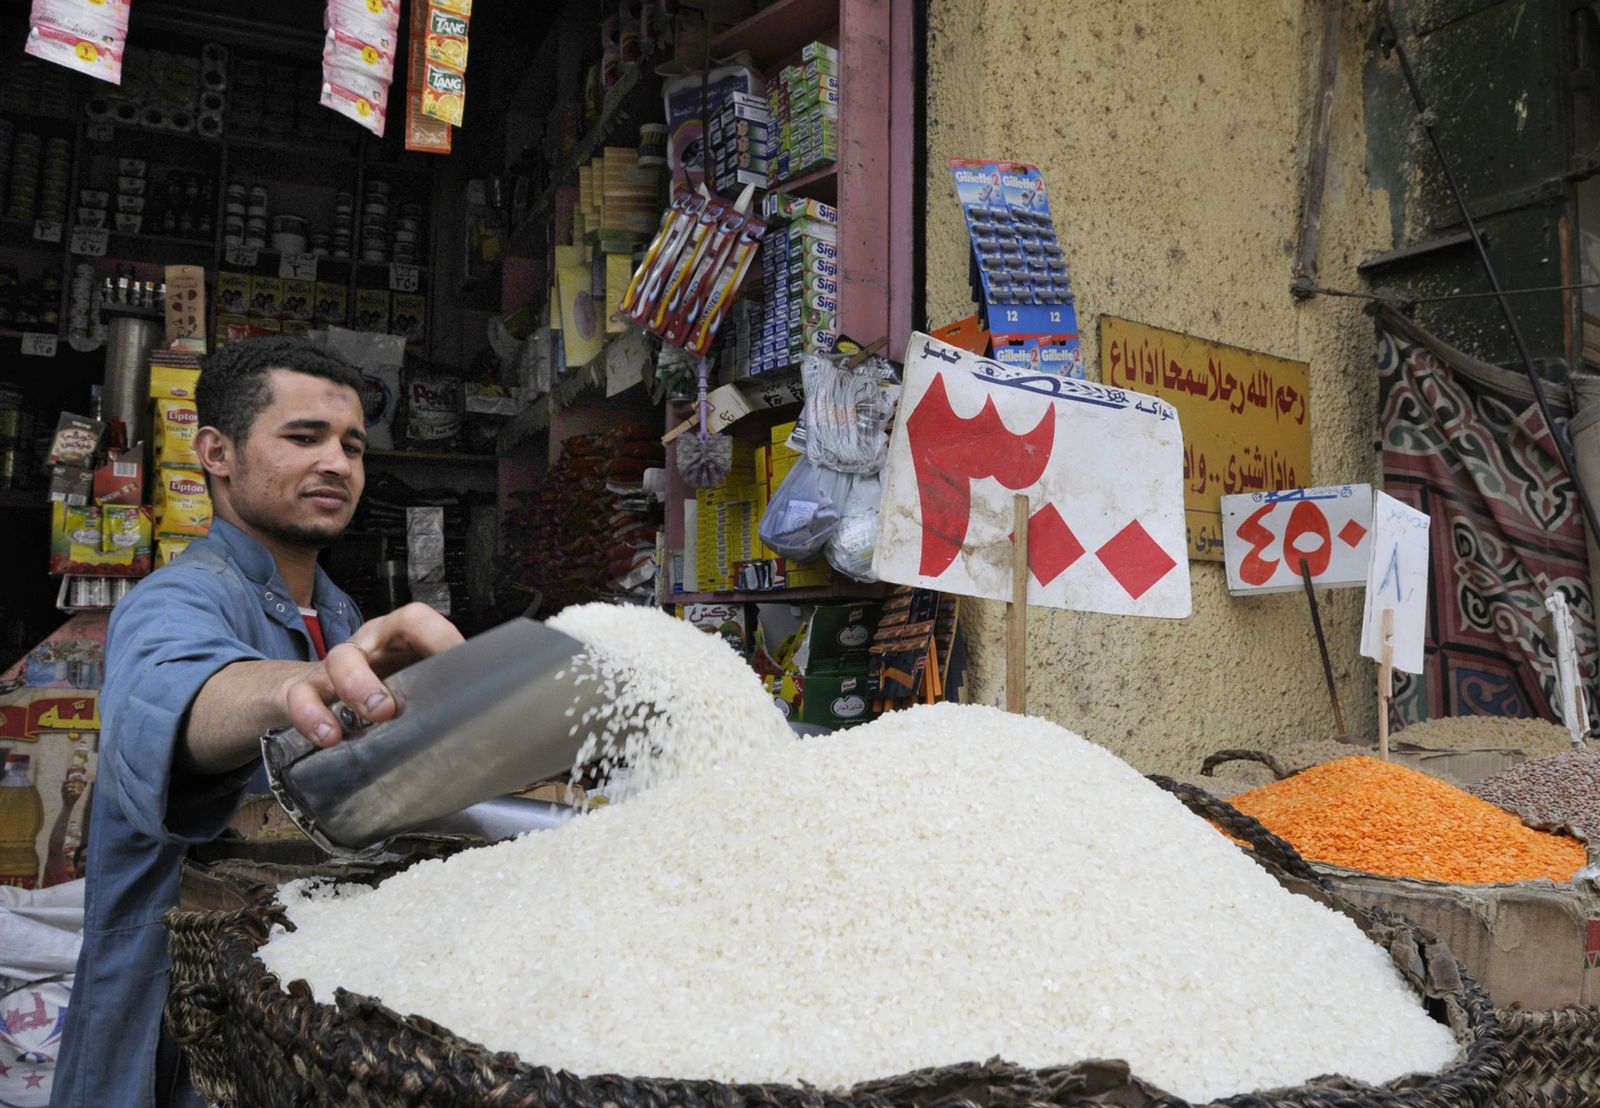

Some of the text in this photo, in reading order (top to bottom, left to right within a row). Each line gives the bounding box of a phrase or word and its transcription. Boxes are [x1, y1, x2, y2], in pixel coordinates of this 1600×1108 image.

[435, 17, 465, 34] TANG
[432, 72, 462, 90] TANG
[955, 170, 1000, 186] Gillette 2
[1002, 175, 1044, 191] Gillette 2
[819, 204, 837, 222] Sig
[816, 242, 837, 258] Sig
[817, 260, 837, 276] Sig
[817, 278, 836, 294] Sig
[817, 296, 836, 312] Sig
[1007, 310, 1018, 322] 12
[1050, 311, 1061, 323] 12
[817, 331, 835, 347] Sig
[997, 348, 1039, 363] Gillette 2
[1041, 348, 1081, 363] Gillette 2
[1110, 337, 1137, 390] باع
[1247, 368, 1274, 409] الله
[1135, 400, 1175, 421] فواكه
[1275, 385, 1306, 426] رحم
[171, 481, 205, 493] Lipton
[1236, 500, 1367, 586] ٤٥٠
